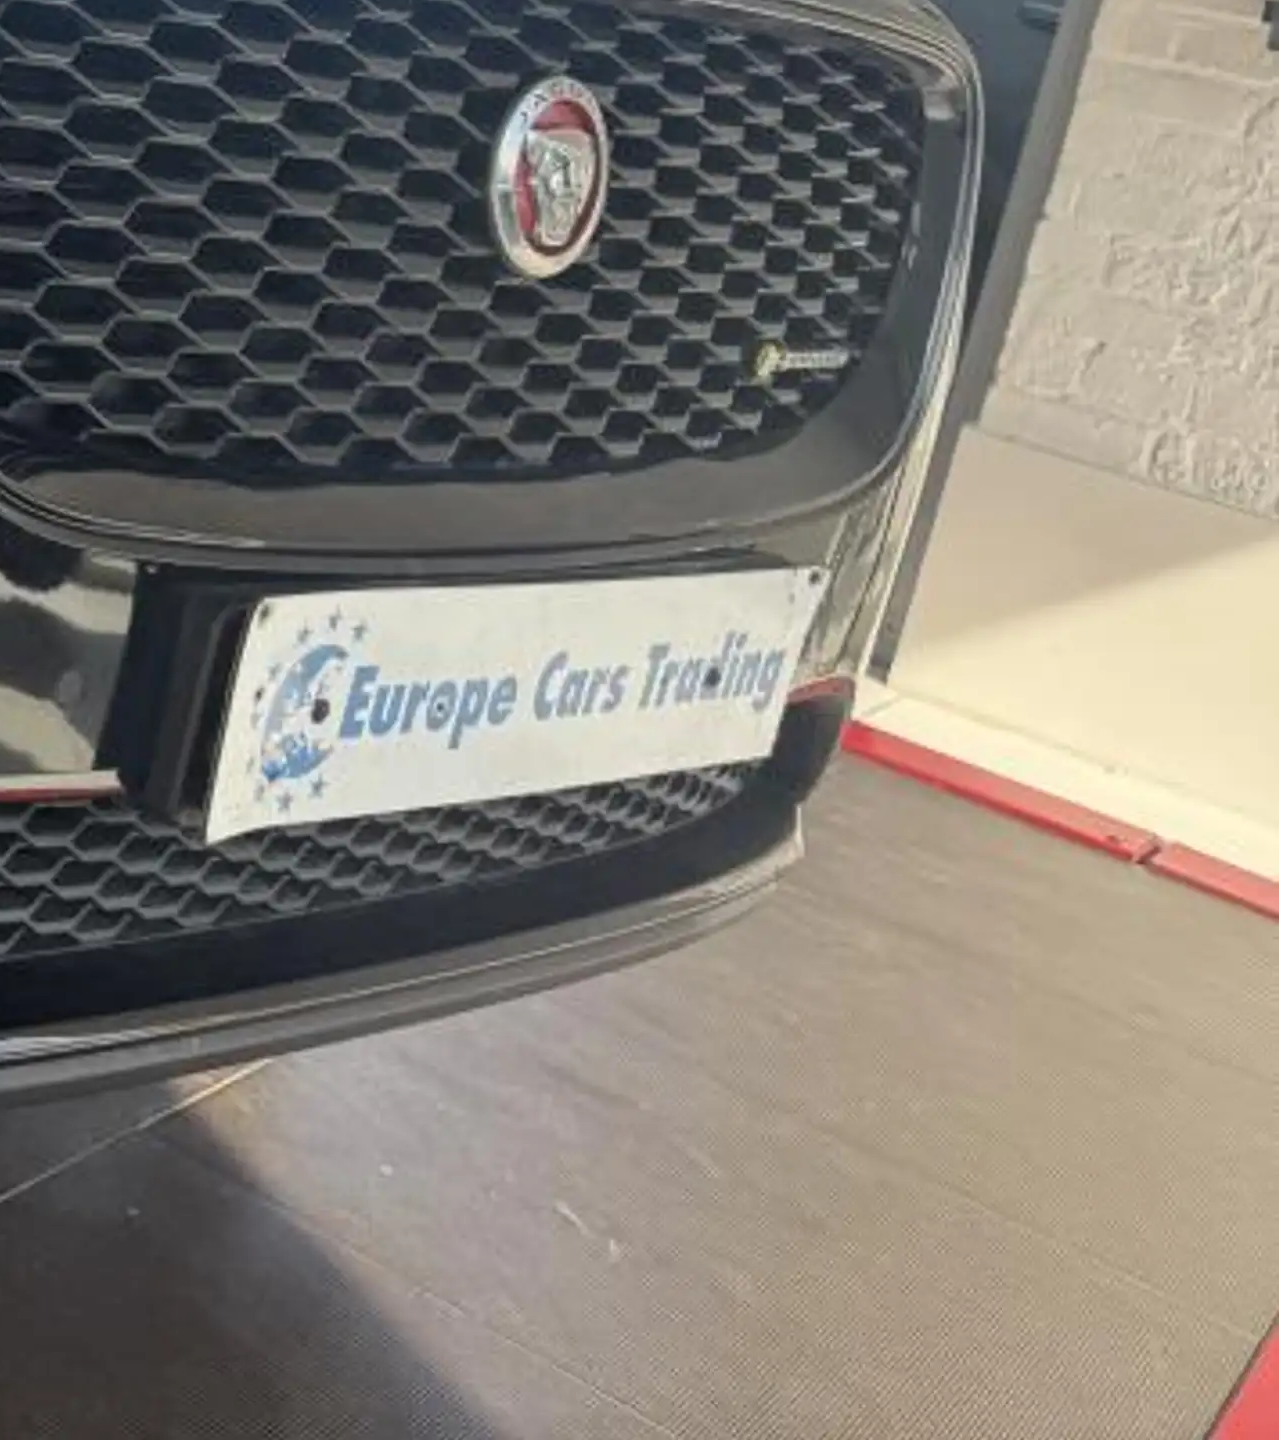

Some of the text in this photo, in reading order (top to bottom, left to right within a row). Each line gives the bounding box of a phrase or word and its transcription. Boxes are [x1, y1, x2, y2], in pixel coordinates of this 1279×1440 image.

[338, 630, 786, 750] Europe Cars Trading
